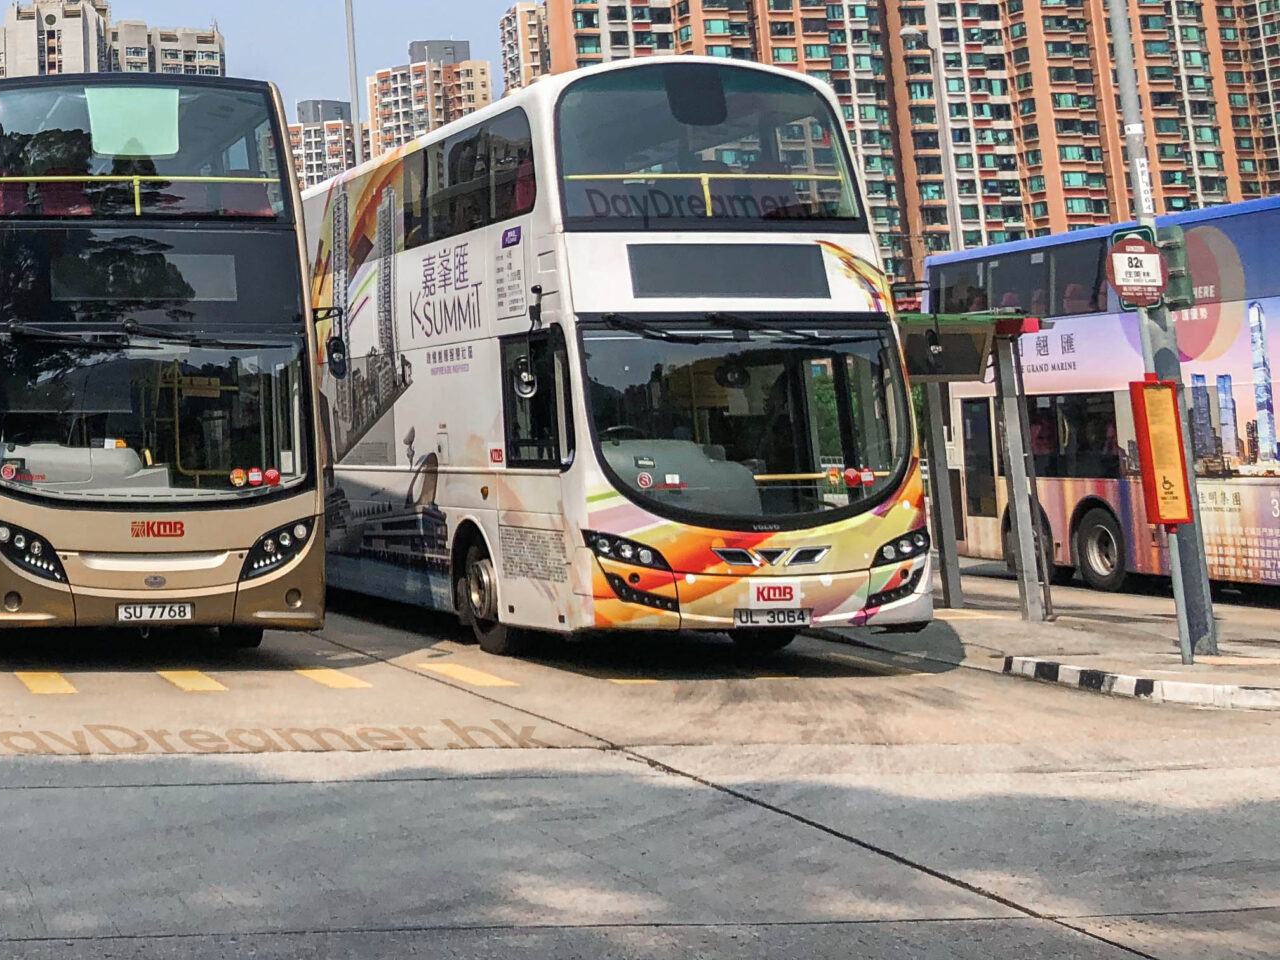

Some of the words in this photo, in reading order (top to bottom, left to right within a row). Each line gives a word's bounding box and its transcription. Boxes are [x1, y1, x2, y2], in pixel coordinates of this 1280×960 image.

[146, 520, 185, 538] KMB
[756, 585, 794, 602] KMB
[123, 605, 144, 620] SU
[147, 604, 187, 619] 7768
[739, 610, 760, 624] UL
[766, 610, 806, 624] 3064
